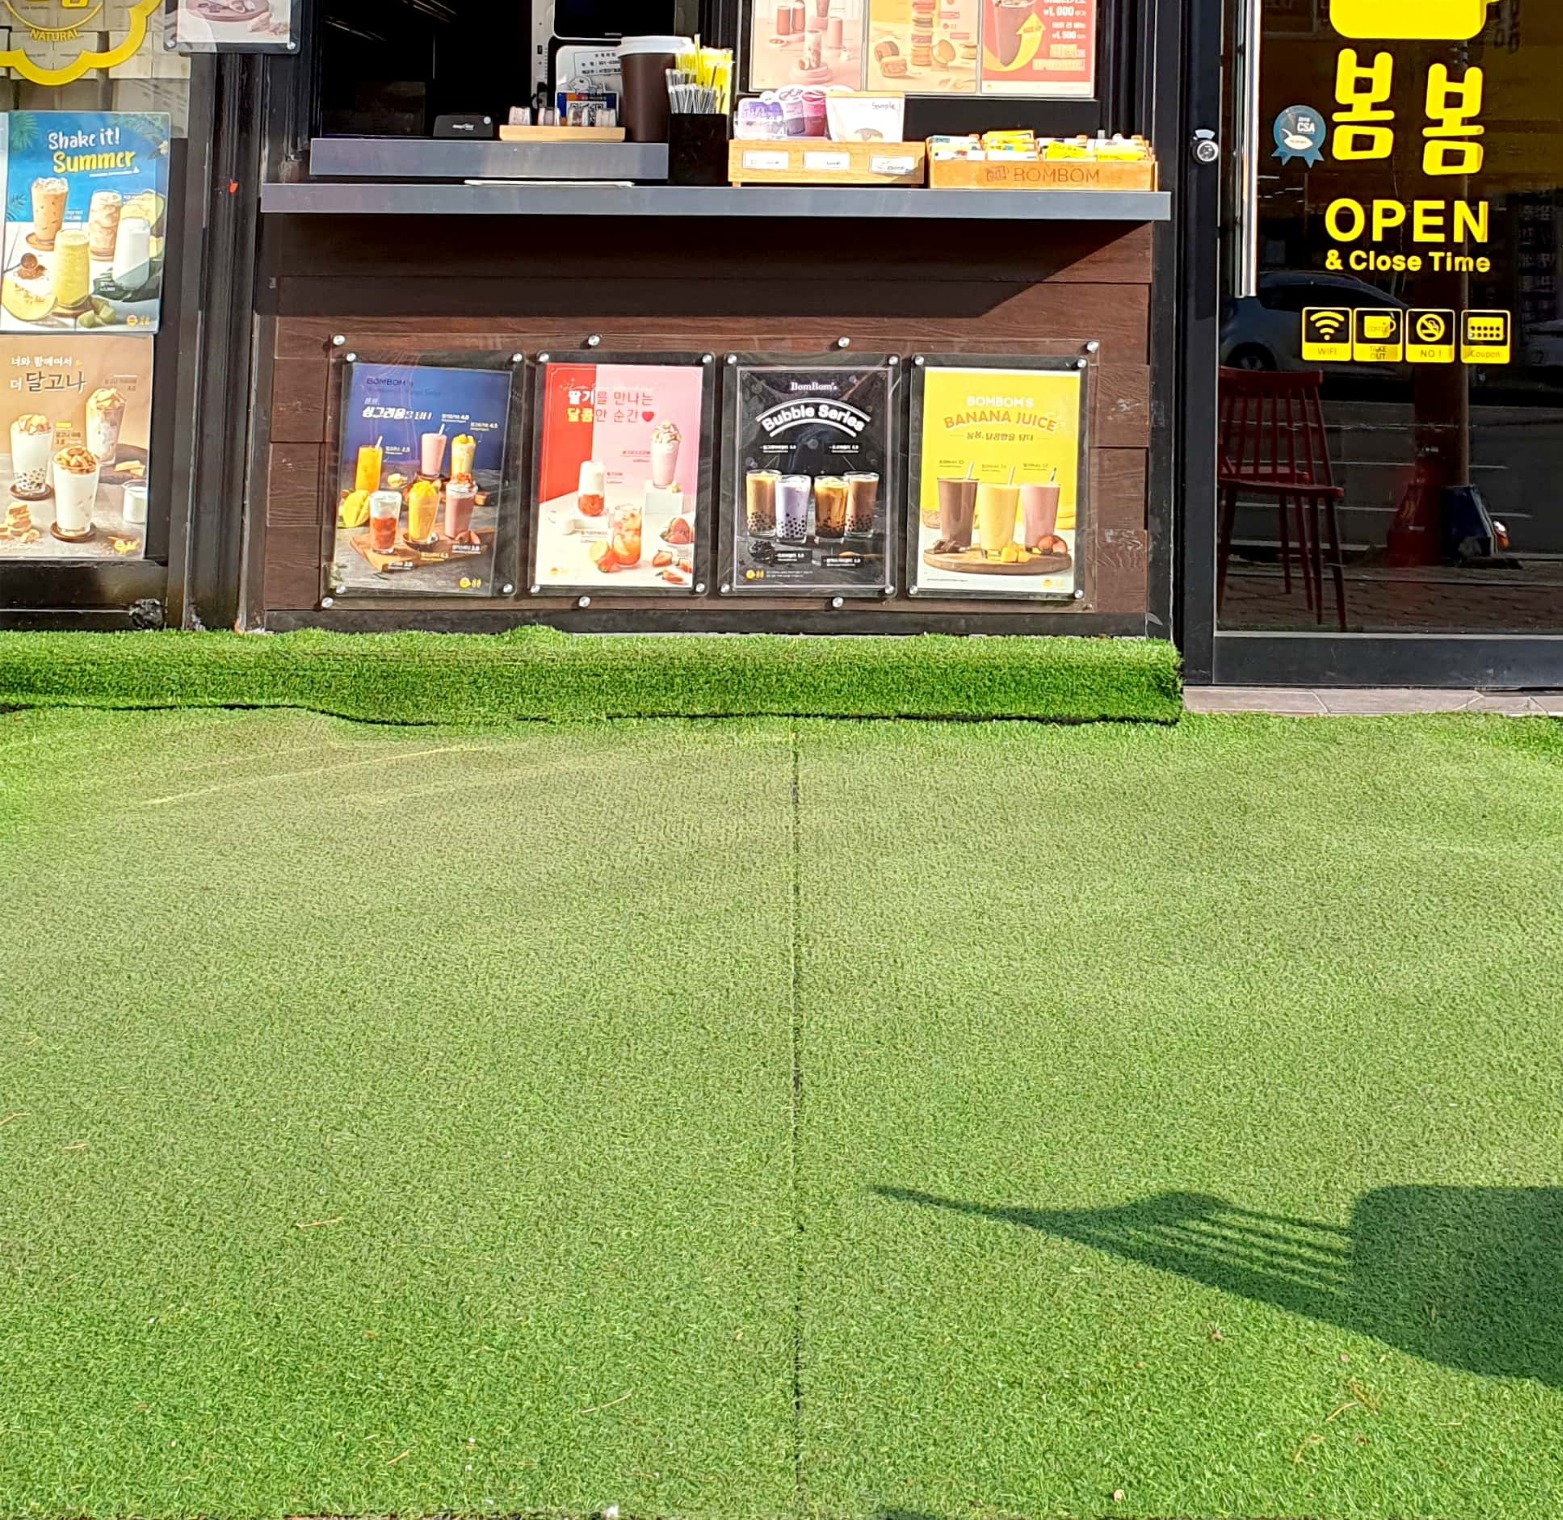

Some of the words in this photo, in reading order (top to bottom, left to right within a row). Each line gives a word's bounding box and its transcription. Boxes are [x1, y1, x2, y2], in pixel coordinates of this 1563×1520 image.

[30, 28, 80, 42] NATURAL
[1332, 48, 1485, 175] 봄봄
[1297, 122, 1315, 132] CSA
[48, 132, 95, 150] Shake
[100, 127, 120, 145] it!
[53, 151, 136, 174] Summer
[1014, 167, 1100, 183] BOMBOM
[1325, 198, 1489, 243] OPEN
[1325, 249, 1343, 271] &
[1350, 250, 1422, 271] Close
[1429, 251, 1490, 272] Time
[11, 356, 31, 367] 너와
[34, 356, 73, 367] 함께여서
[1420, 350, 1434, 358] NO
[1469, 350, 1500, 359] Coupon
[10, 377, 22, 391] 더
[26, 370, 87, 394] 달고나
[790, 382, 838, 392] BomBom's
[568, 390, 608, 405] 딸기를
[613, 392, 654, 406] 만나는
[966, 396, 1034, 408] BOMBOM'S
[567, 408, 607, 423] 달콤한
[613, 409, 639, 423] 순간
[761, 405, 815, 432] Bubble
[818, 405, 866, 432] Series
[944, 410, 1012, 429] BANANA
[1016, 412, 1057, 432] JUICE
